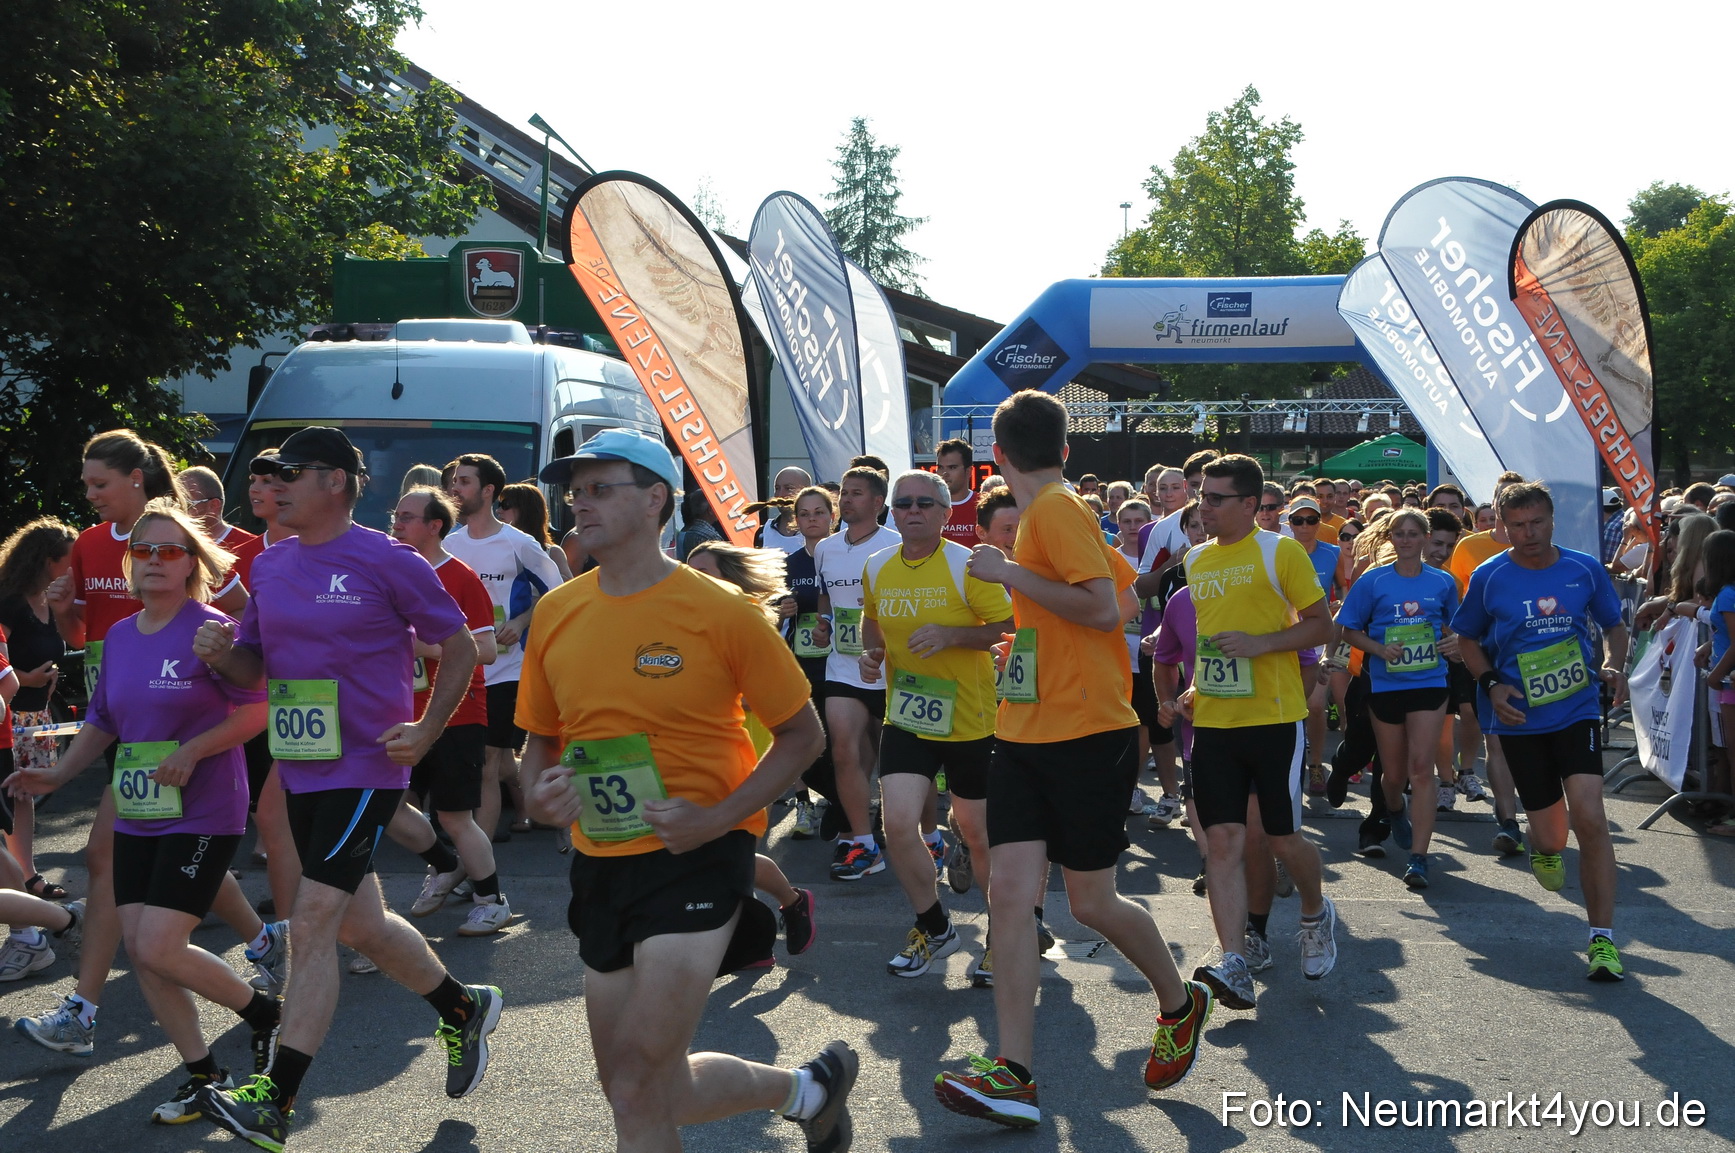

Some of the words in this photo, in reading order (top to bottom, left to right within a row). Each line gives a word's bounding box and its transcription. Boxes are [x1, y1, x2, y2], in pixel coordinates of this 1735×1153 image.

[481, 301, 506, 311] 1628
[1191, 318, 1290, 336] firmenlauf
[1005, 353, 1057, 364] Fischer
[1222, 564, 1256, 577] STEYR
[329, 574, 349, 593] K
[792, 577, 814, 587] EURO
[1189, 577, 1229, 601] RUN
[1230, 575, 1253, 586] 2014
[315, 593, 362, 602] KÜFNER
[880, 588, 912, 598] MAGNA
[913, 586, 947, 598] STEYR
[878, 599, 920, 617] RUN
[923, 599, 948, 609] 2014
[1393, 604, 1402, 617] I
[1522, 600, 1535, 619] I
[1525, 615, 1573, 628] camping
[800, 628, 813, 647] 3
[160, 659, 180, 678] K
[1200, 657, 1239, 683] 731
[1529, 661, 1584, 698] 5036
[899, 691, 943, 722] 736
[275, 707, 326, 740] 606
[120, 769, 160, 800] 607
[588, 774, 636, 815] 53
[695, 902, 714, 910] JAKO
